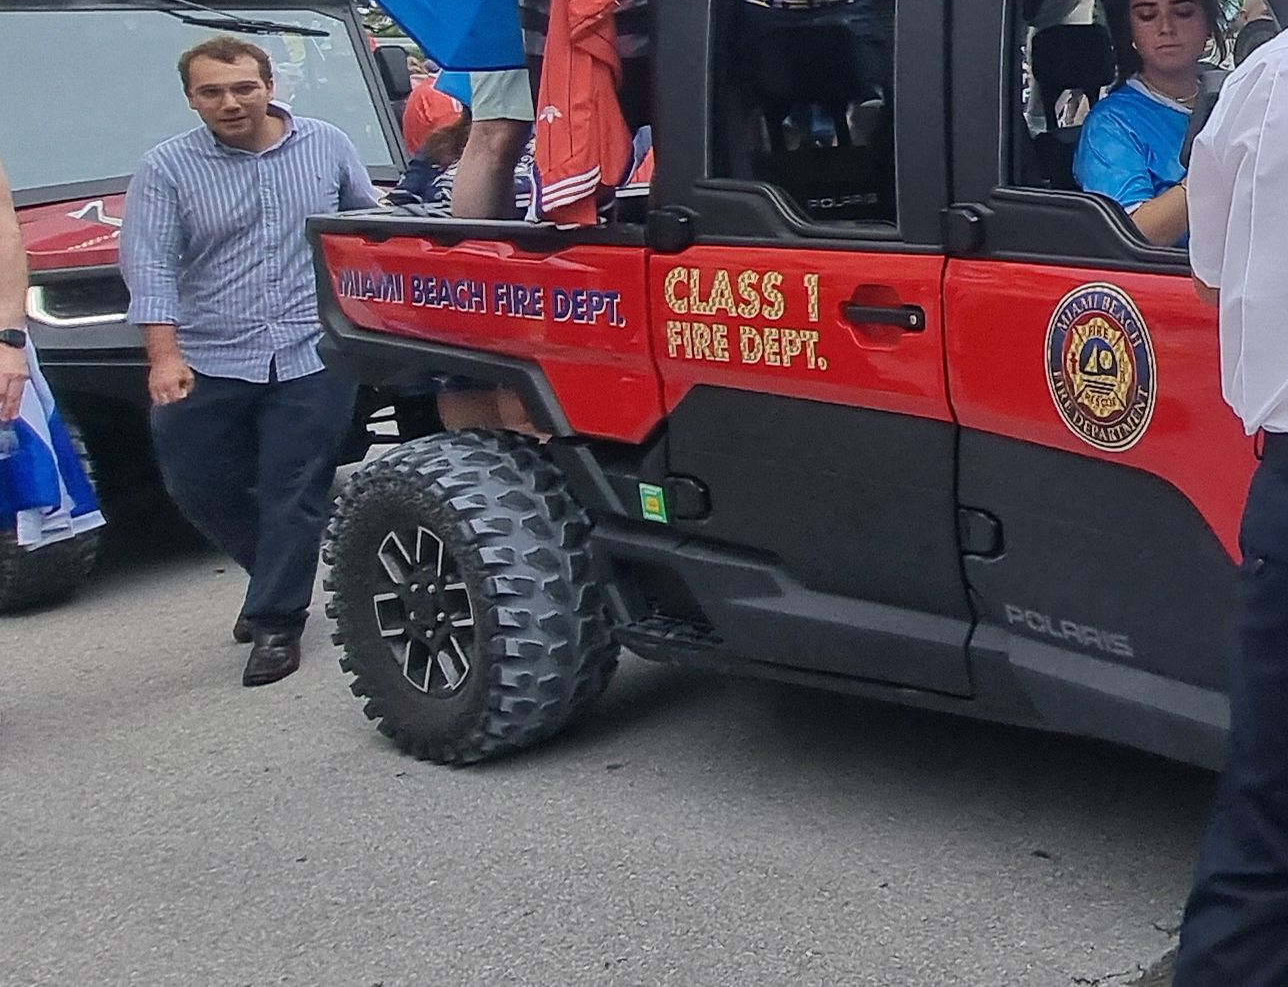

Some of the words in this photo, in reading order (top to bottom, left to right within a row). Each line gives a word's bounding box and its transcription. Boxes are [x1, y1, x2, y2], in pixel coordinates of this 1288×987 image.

[339, 270, 404, 304] MIAMI
[411, 275, 487, 314] BEACH
[493, 282, 545, 320] FIRE
[552, 287, 627, 328] DEPT.
[664, 266, 786, 320] CLASS
[803, 273, 820, 322] 1
[666, 320, 730, 362] FIRE
[739, 325, 828, 371] DEPT.
[1056, 294, 1098, 334] MIAMI
[1101, 297, 1144, 349] BEACH
[1087, 325, 1109, 341] FIRE
[1052, 369, 1072, 414] FIRE
[1072, 383, 1150, 442] DEPARTMENT
[1084, 391, 1117, 408] RESCUE
[1003, 603, 1134, 657] POLARIS
